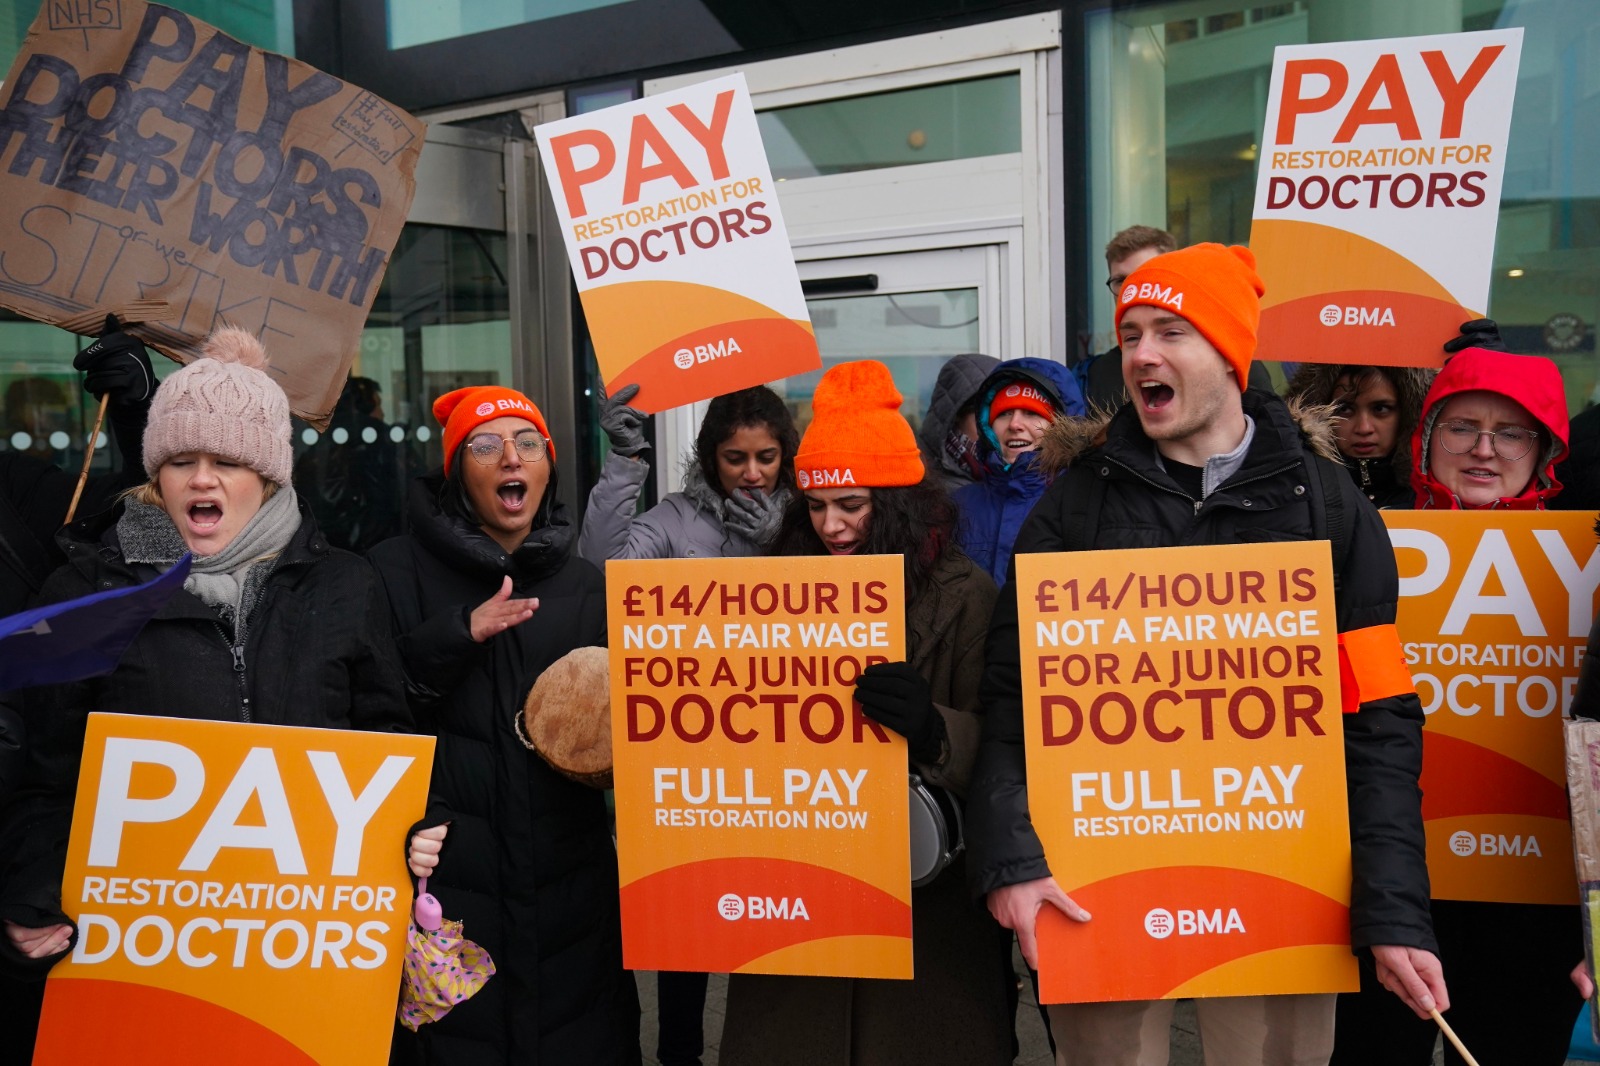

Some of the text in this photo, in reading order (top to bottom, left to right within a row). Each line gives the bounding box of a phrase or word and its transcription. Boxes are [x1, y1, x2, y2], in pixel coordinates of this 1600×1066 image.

[55, 0, 114, 25] NHS
[123, 4, 343, 143] PAY
[1275, 45, 1506, 145] PAY
[5, 54, 382, 242] DOCTORS
[549, 89, 735, 219] PAY
[1271, 144, 1492, 170] RESTORATION FOR
[1266, 171, 1488, 210] DOCTORS
[573, 177, 763, 242] RESTORATION FOR
[188, 181, 387, 307] WORTH
[580, 201, 773, 281] DOCTORS
[1138, 283, 1184, 310] BMA
[1344, 307, 1395, 327] BMA
[695, 337, 742, 364] BMA
[496, 398, 534, 414] BMA
[812, 468, 856, 486] BMA
[623, 580, 889, 617] £14/HOUR IS
[1035, 567, 1317, 613] £14/HOUR IS
[623, 622, 889, 649] NOT A FAIR WAGE
[1036, 610, 1320, 647] NOT A FAIR WAGE
[625, 657, 701, 687] FOR
[710, 657, 738, 687] A
[1039, 644, 1323, 688] FOR A JUNIOR
[1042, 685, 1327, 746] DOCTOR
[653, 768, 868, 806] FULL PAY
[1072, 765, 1304, 812] FULL PAY
[87, 737, 416, 876] PAY
[655, 810, 868, 829] RESTORATION NOW
[1073, 809, 1305, 837] RESTORATION NOW
[1479, 833, 1543, 858] BMA
[81, 876, 397, 912] RESTORATION FOR
[748, 897, 810, 921] BMA
[1177, 908, 1246, 936] BMA
[71, 914, 390, 970] DOCTORS
